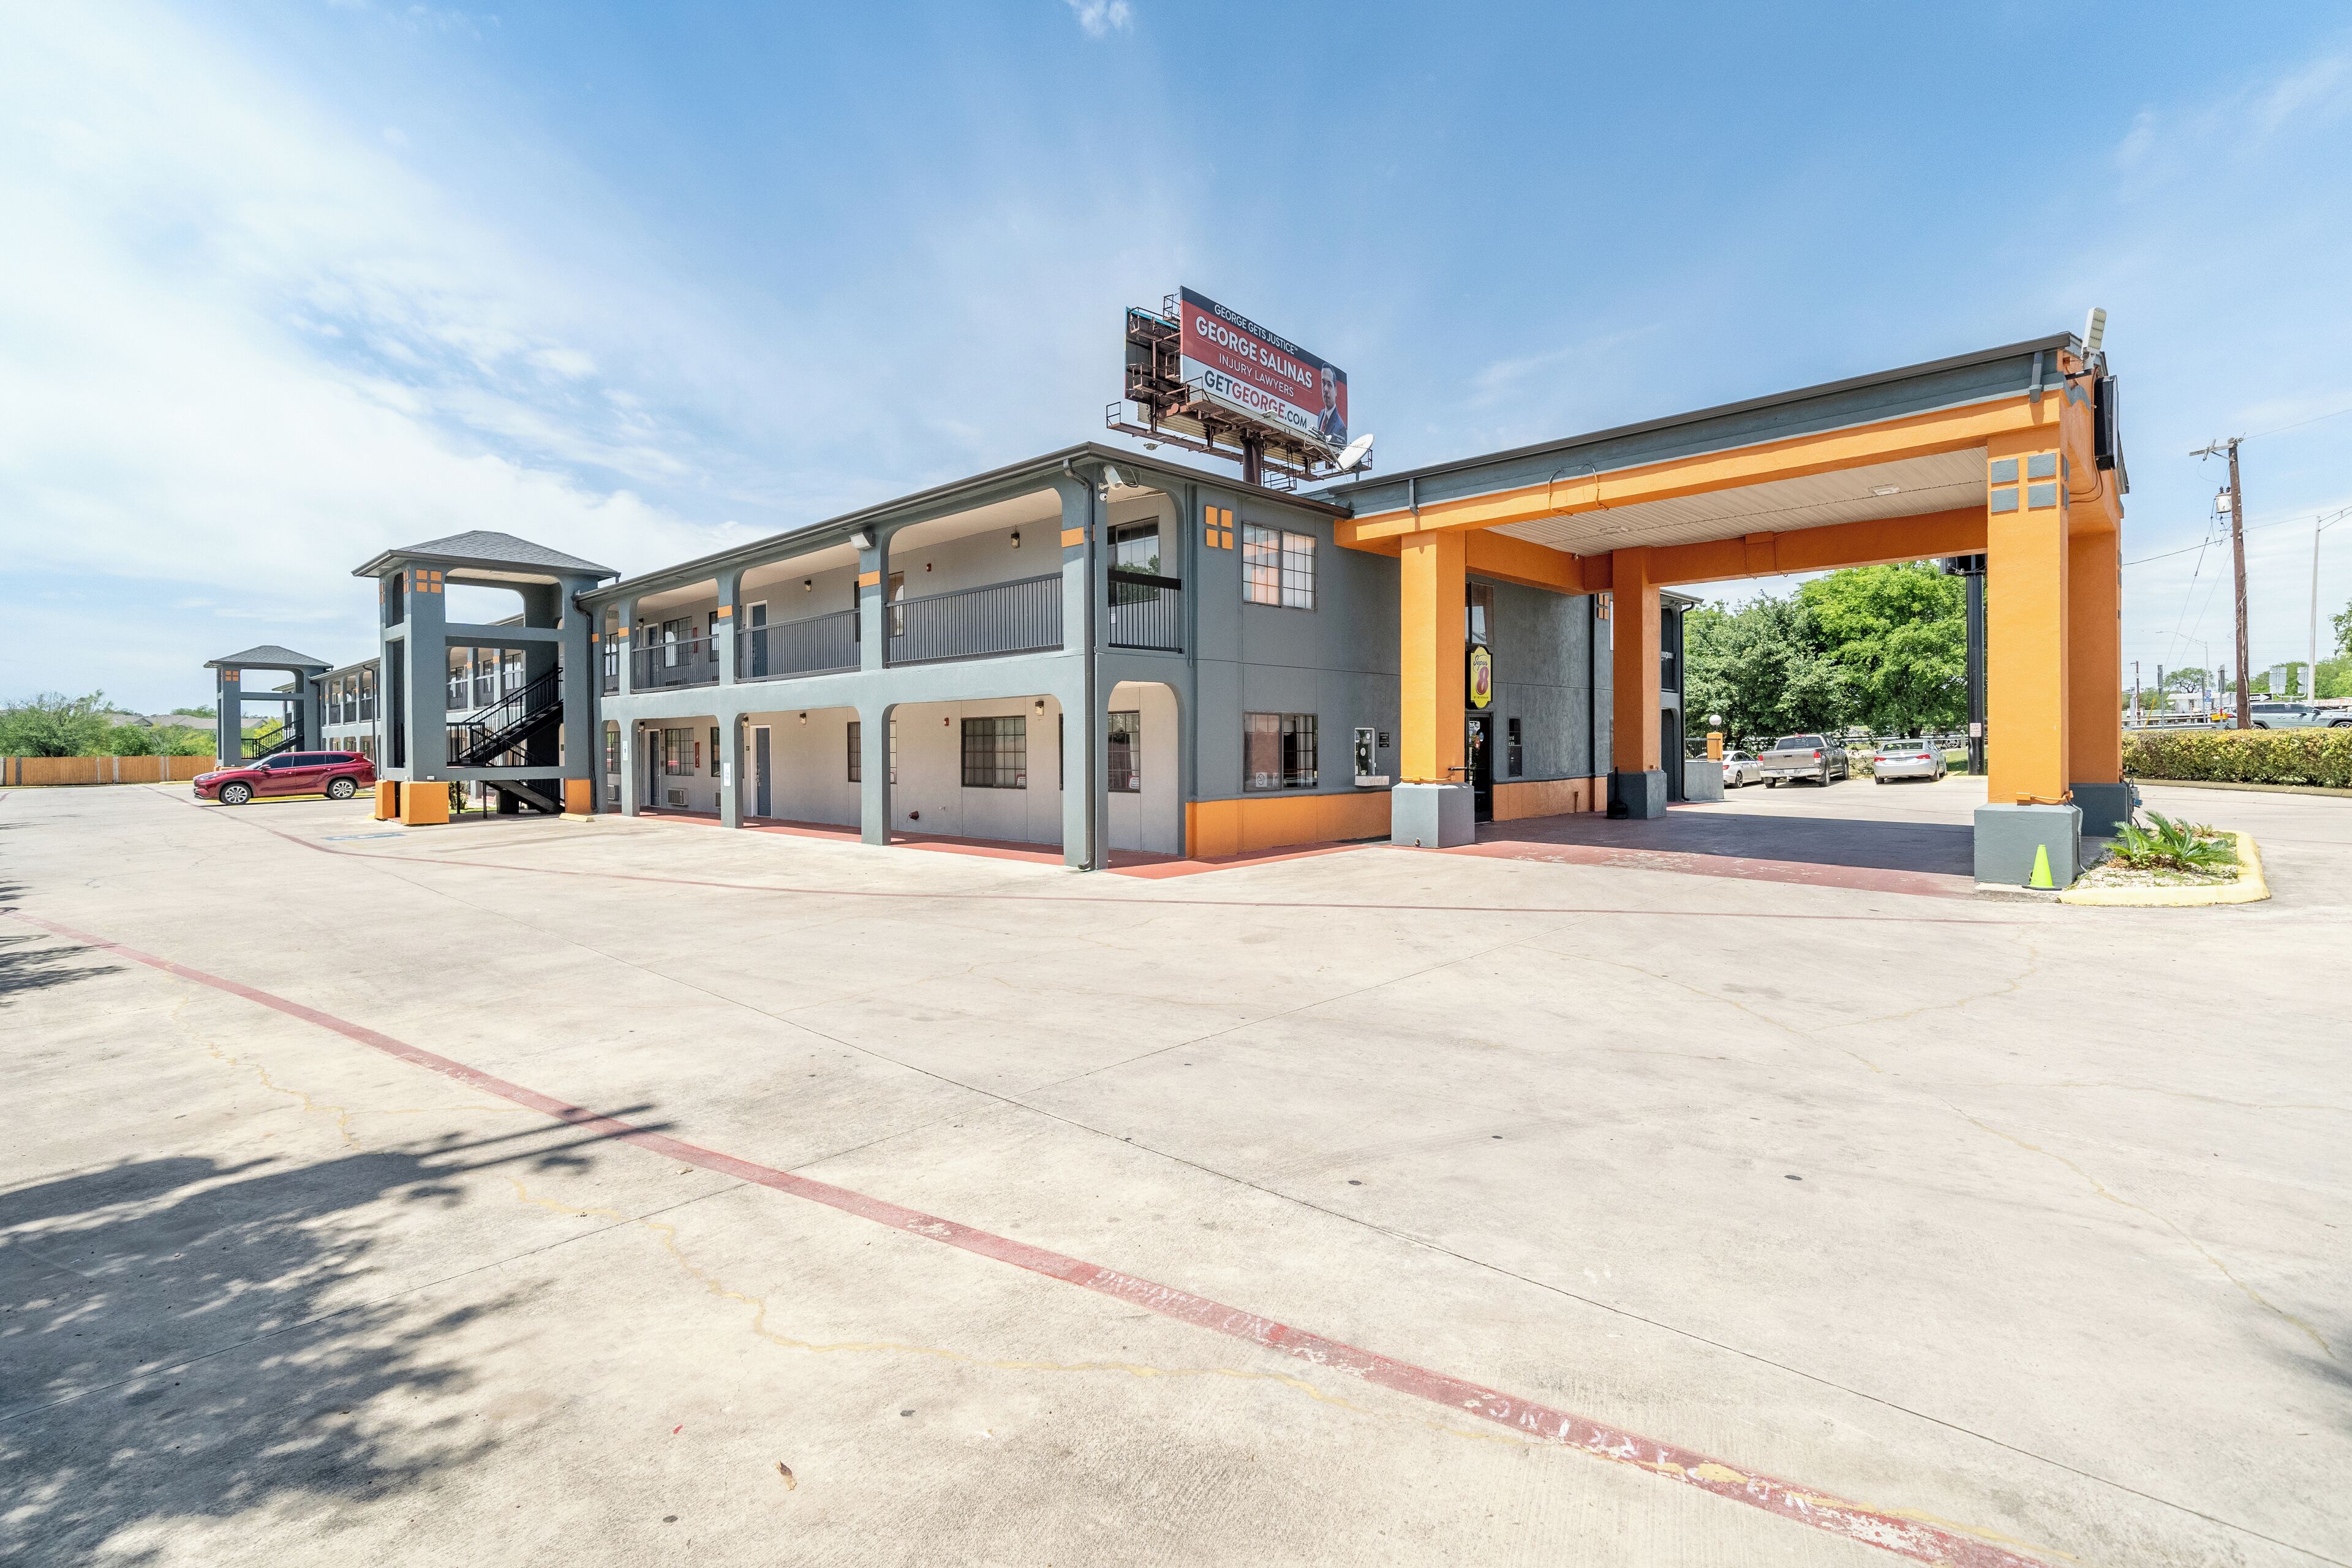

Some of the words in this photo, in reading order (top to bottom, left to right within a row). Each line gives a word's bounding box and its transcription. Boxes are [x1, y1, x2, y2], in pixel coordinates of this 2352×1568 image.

[1215, 304, 1246, 330] GEORGE
[1248, 322, 1266, 339] GETS
[1196, 315, 1257, 362] GEORGE
[1259, 348, 1313, 388] SALINAS
[1219, 353, 1253, 377] INJURY
[1255, 370, 1294, 398] LAWYERS
[1204, 370, 1307, 428] GETGEORGE.COM
[1473, 655, 1488, 671] Super
[1476, 666, 1489, 695] 8
[1222, 1313, 1275, 1341] NO
